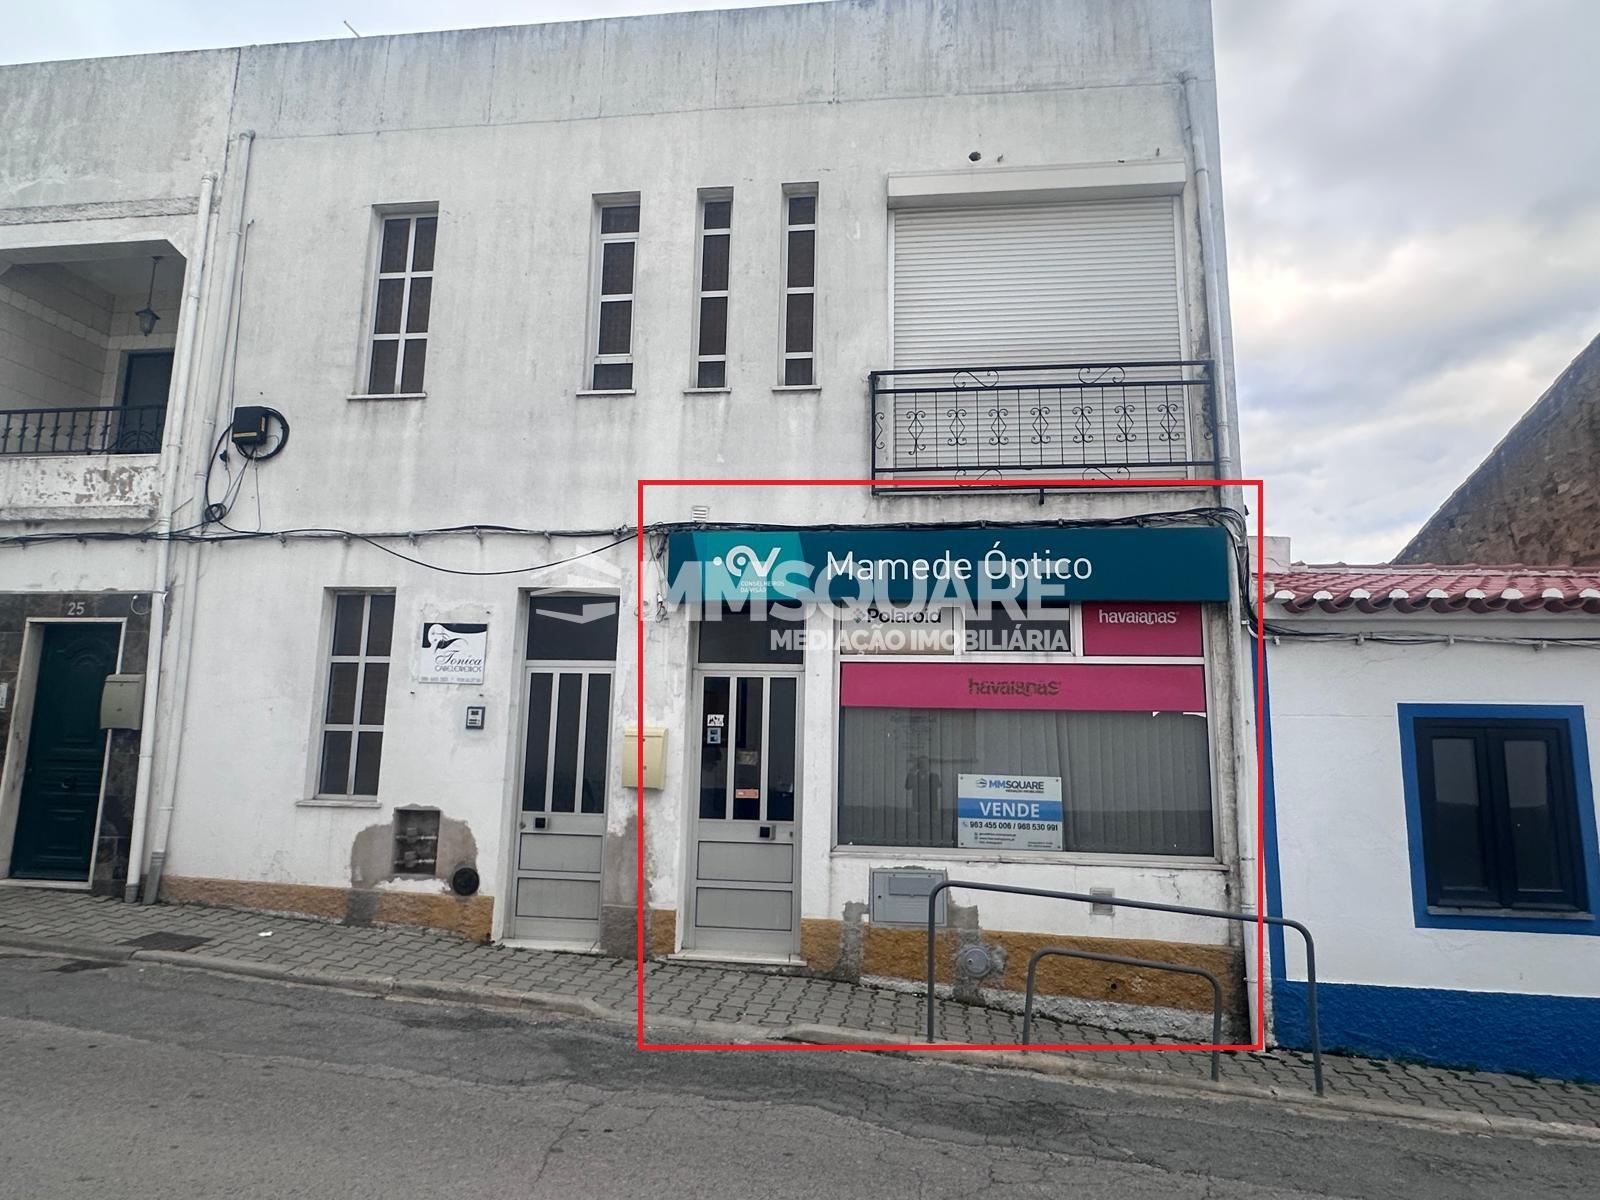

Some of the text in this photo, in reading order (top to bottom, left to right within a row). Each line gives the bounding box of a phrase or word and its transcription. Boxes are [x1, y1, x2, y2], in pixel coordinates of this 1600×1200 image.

[826, 541, 1092, 588] Mamede Óptico
[67, 601, 86, 616] 25
[867, 607, 942, 623] Polaroid
[1098, 609, 1178, 625] havaianas
[968, 678, 1061, 697] havaianas
[989, 780, 1044, 790] MMSQUARE
[979, 801, 1040, 818] VENDE
[1032, 823, 1046, 831] 530
